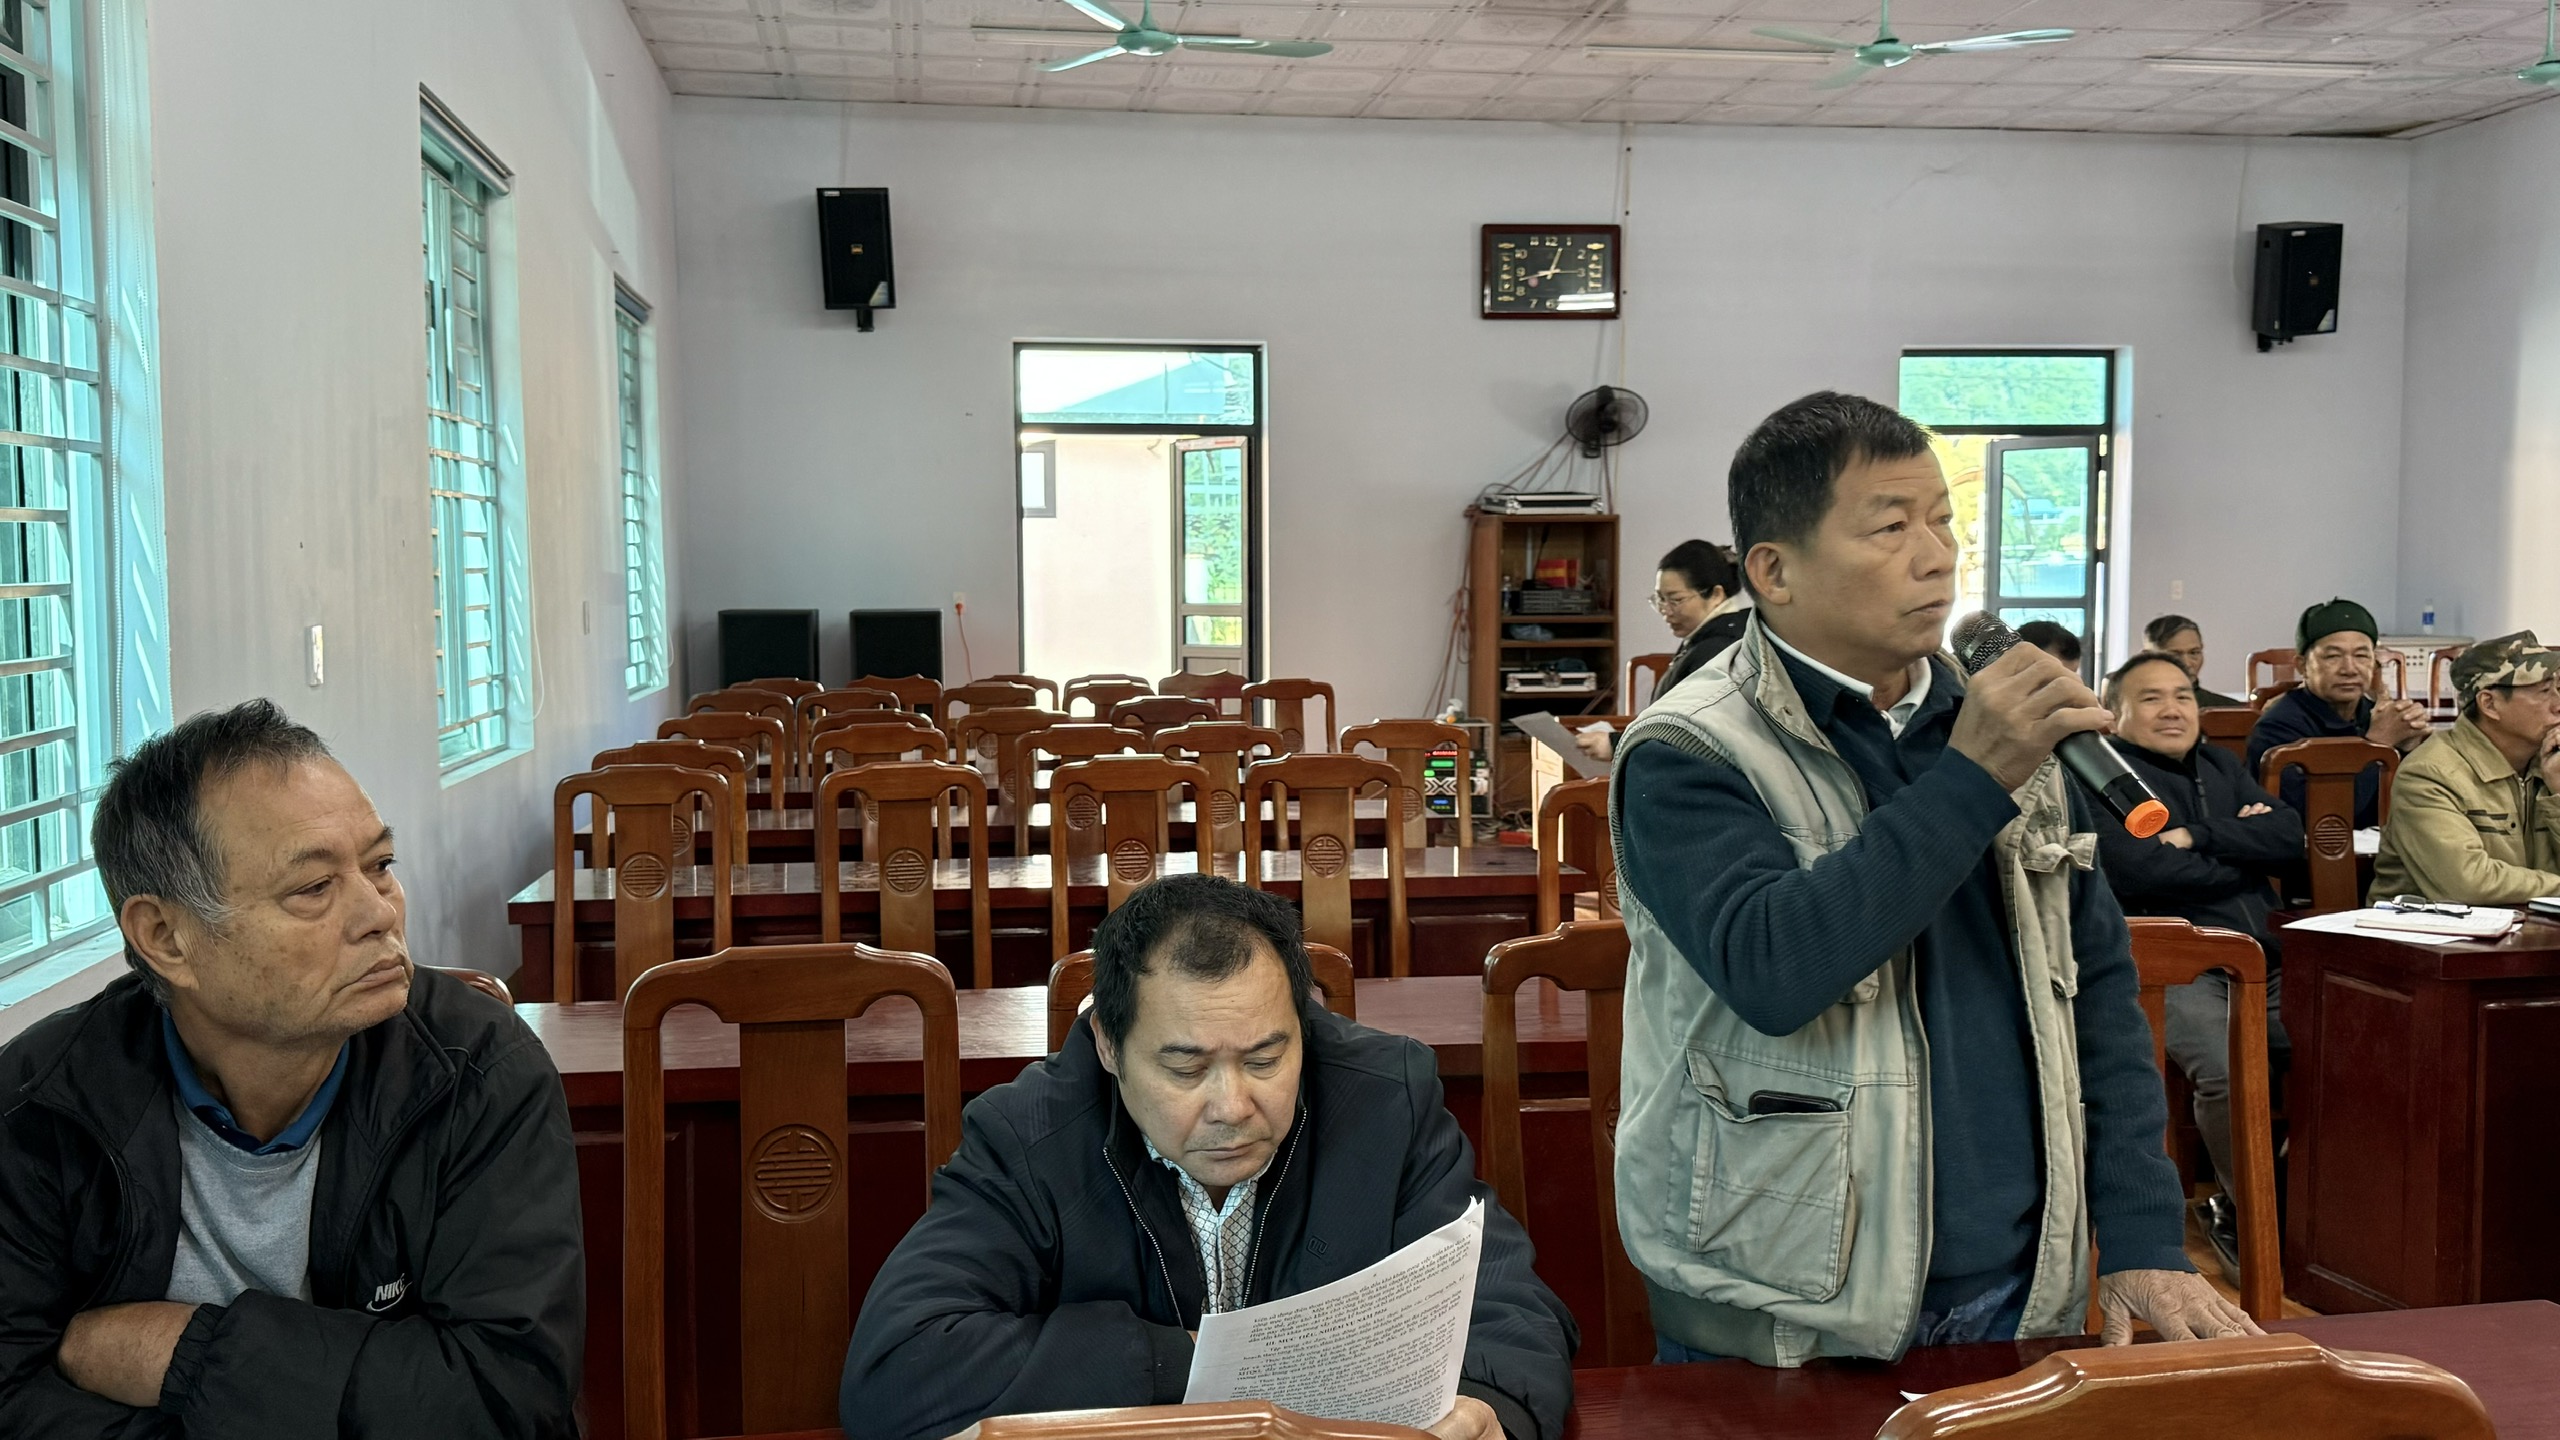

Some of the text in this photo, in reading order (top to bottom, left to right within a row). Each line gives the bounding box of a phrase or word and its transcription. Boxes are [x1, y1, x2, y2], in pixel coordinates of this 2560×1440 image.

[1545, 236, 1558, 246] 12
[1515, 249, 1528, 259] 10
[1577, 249, 1586, 260] 2
[1516, 267, 1525, 277] 9
[1577, 268, 1586, 277] 3
[1516, 286, 1526, 296] 8
[1530, 299, 1538, 309] 7
